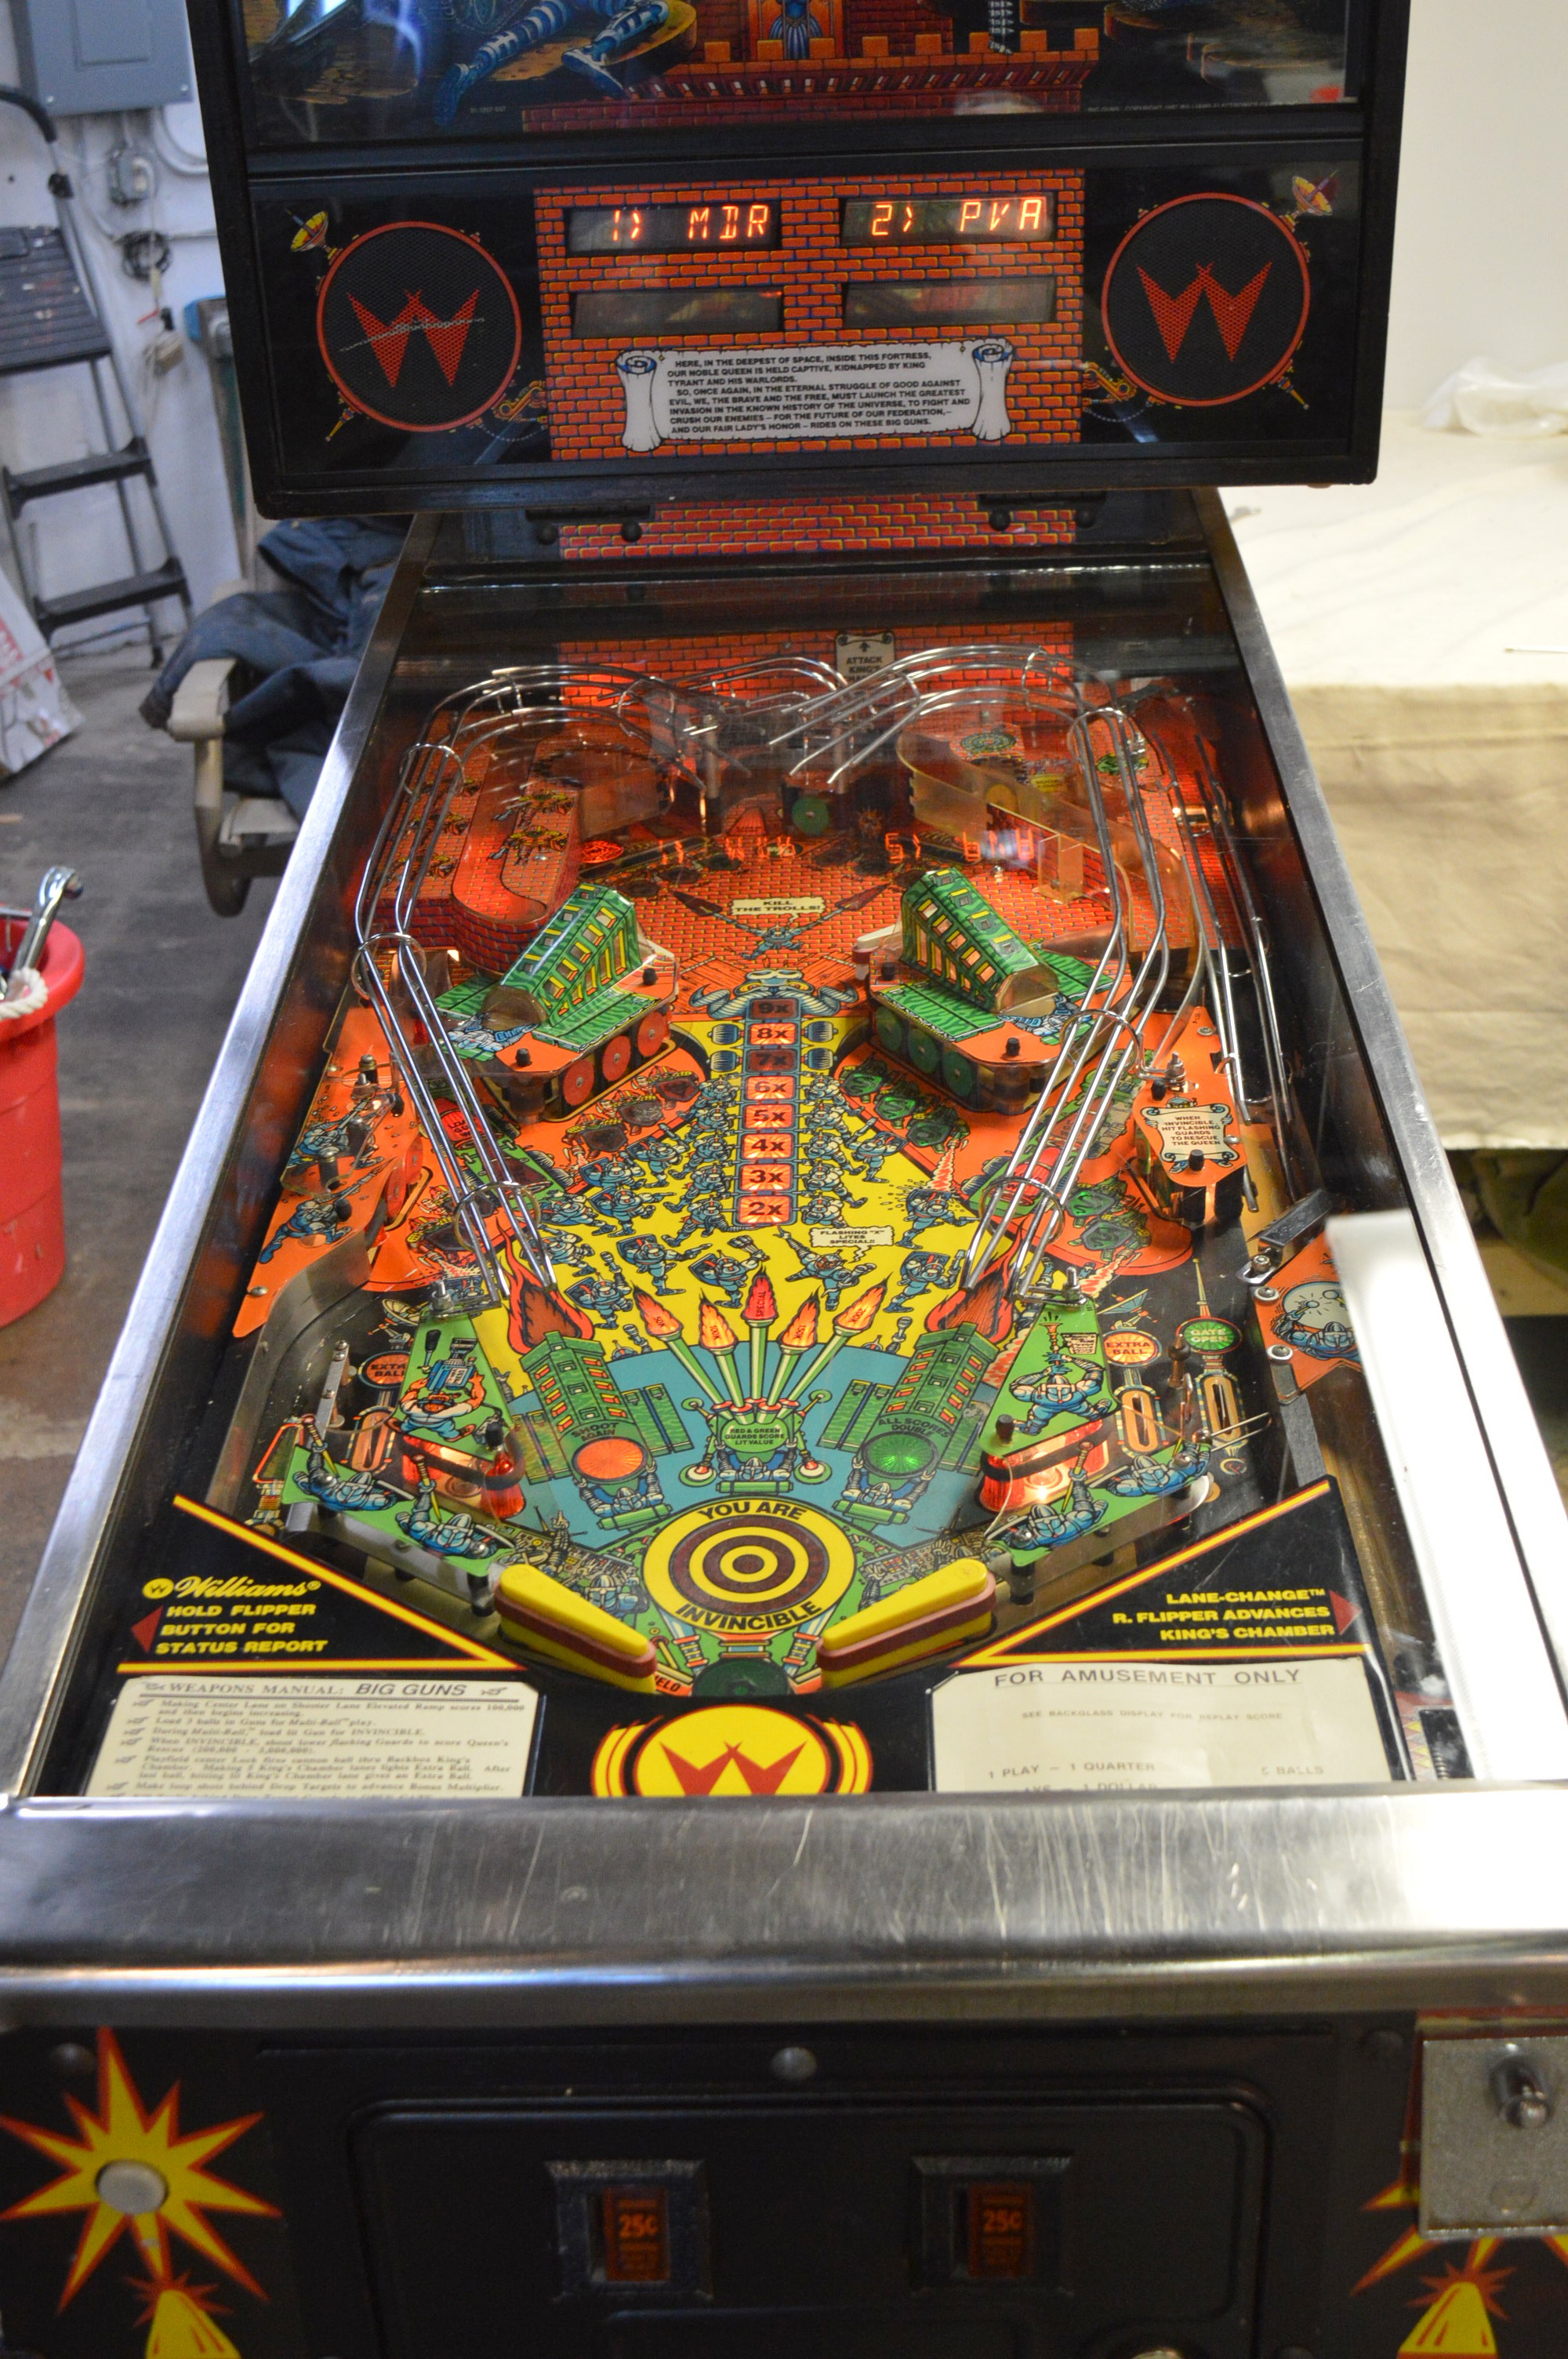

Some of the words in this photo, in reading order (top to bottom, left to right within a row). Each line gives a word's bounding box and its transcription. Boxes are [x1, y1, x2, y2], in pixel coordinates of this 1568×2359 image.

[688, 204, 770, 240] MDR
[959, 197, 1043, 233] PVA
[735, 357, 776, 365] DEEPEST
[834, 362, 887, 371] KIDNAPPED
[785, 383, 826, 392] ETERNAL
[828, 382, 877, 391] STRUGGLE
[919, 388, 965, 397] GREATEST
[756, 1290, 766, 1317] SPECIAL
[848, 1307, 866, 1324] 200K
[710, 1325, 720, 1340] 100K
[572, 1422, 619, 1438] SHOOT
[581, 1428, 615, 1441] AGAIN
[891, 1424, 935, 1437] DOUBLE
[905, 1417, 951, 1438] SCORES
[696, 1501, 750, 1521] YOU
[755, 1501, 808, 1521] ARE
[166, 1605, 223, 1617] HOLD
[230, 1604, 317, 1616] FLIPPER
[675, 1601, 822, 1630] INVINCIBLE
[1112, 1613, 1133, 1624] R.
[1137, 1610, 1218, 1623] FLIPPER
[1222, 1606, 1330, 1621] ADVANCES
[160, 1623, 247, 1636] BUTTON
[252, 1622, 296, 1634] FOR
[1160, 1627, 1230, 1641] KING'S
[1233, 1624, 1335, 1639] CHAMBER
[155, 1641, 238, 1655] STATUS
[243, 1640, 328, 1652] REPORT
[994, 1670, 1044, 1687] FOR
[1062, 1669, 1216, 1685] AMUSEMENT
[1234, 1669, 1299, 1684] ONLY
[169, 1683, 255, 1694] WEAPONS
[261, 1685, 343, 1695] MANUAL:
[355, 1683, 394, 1696] BIG
[402, 1684, 468, 1696] GUNS
[1002, 1765, 1040, 1778] PLAY
[1083, 1762, 1156, 1771] QUARTER
